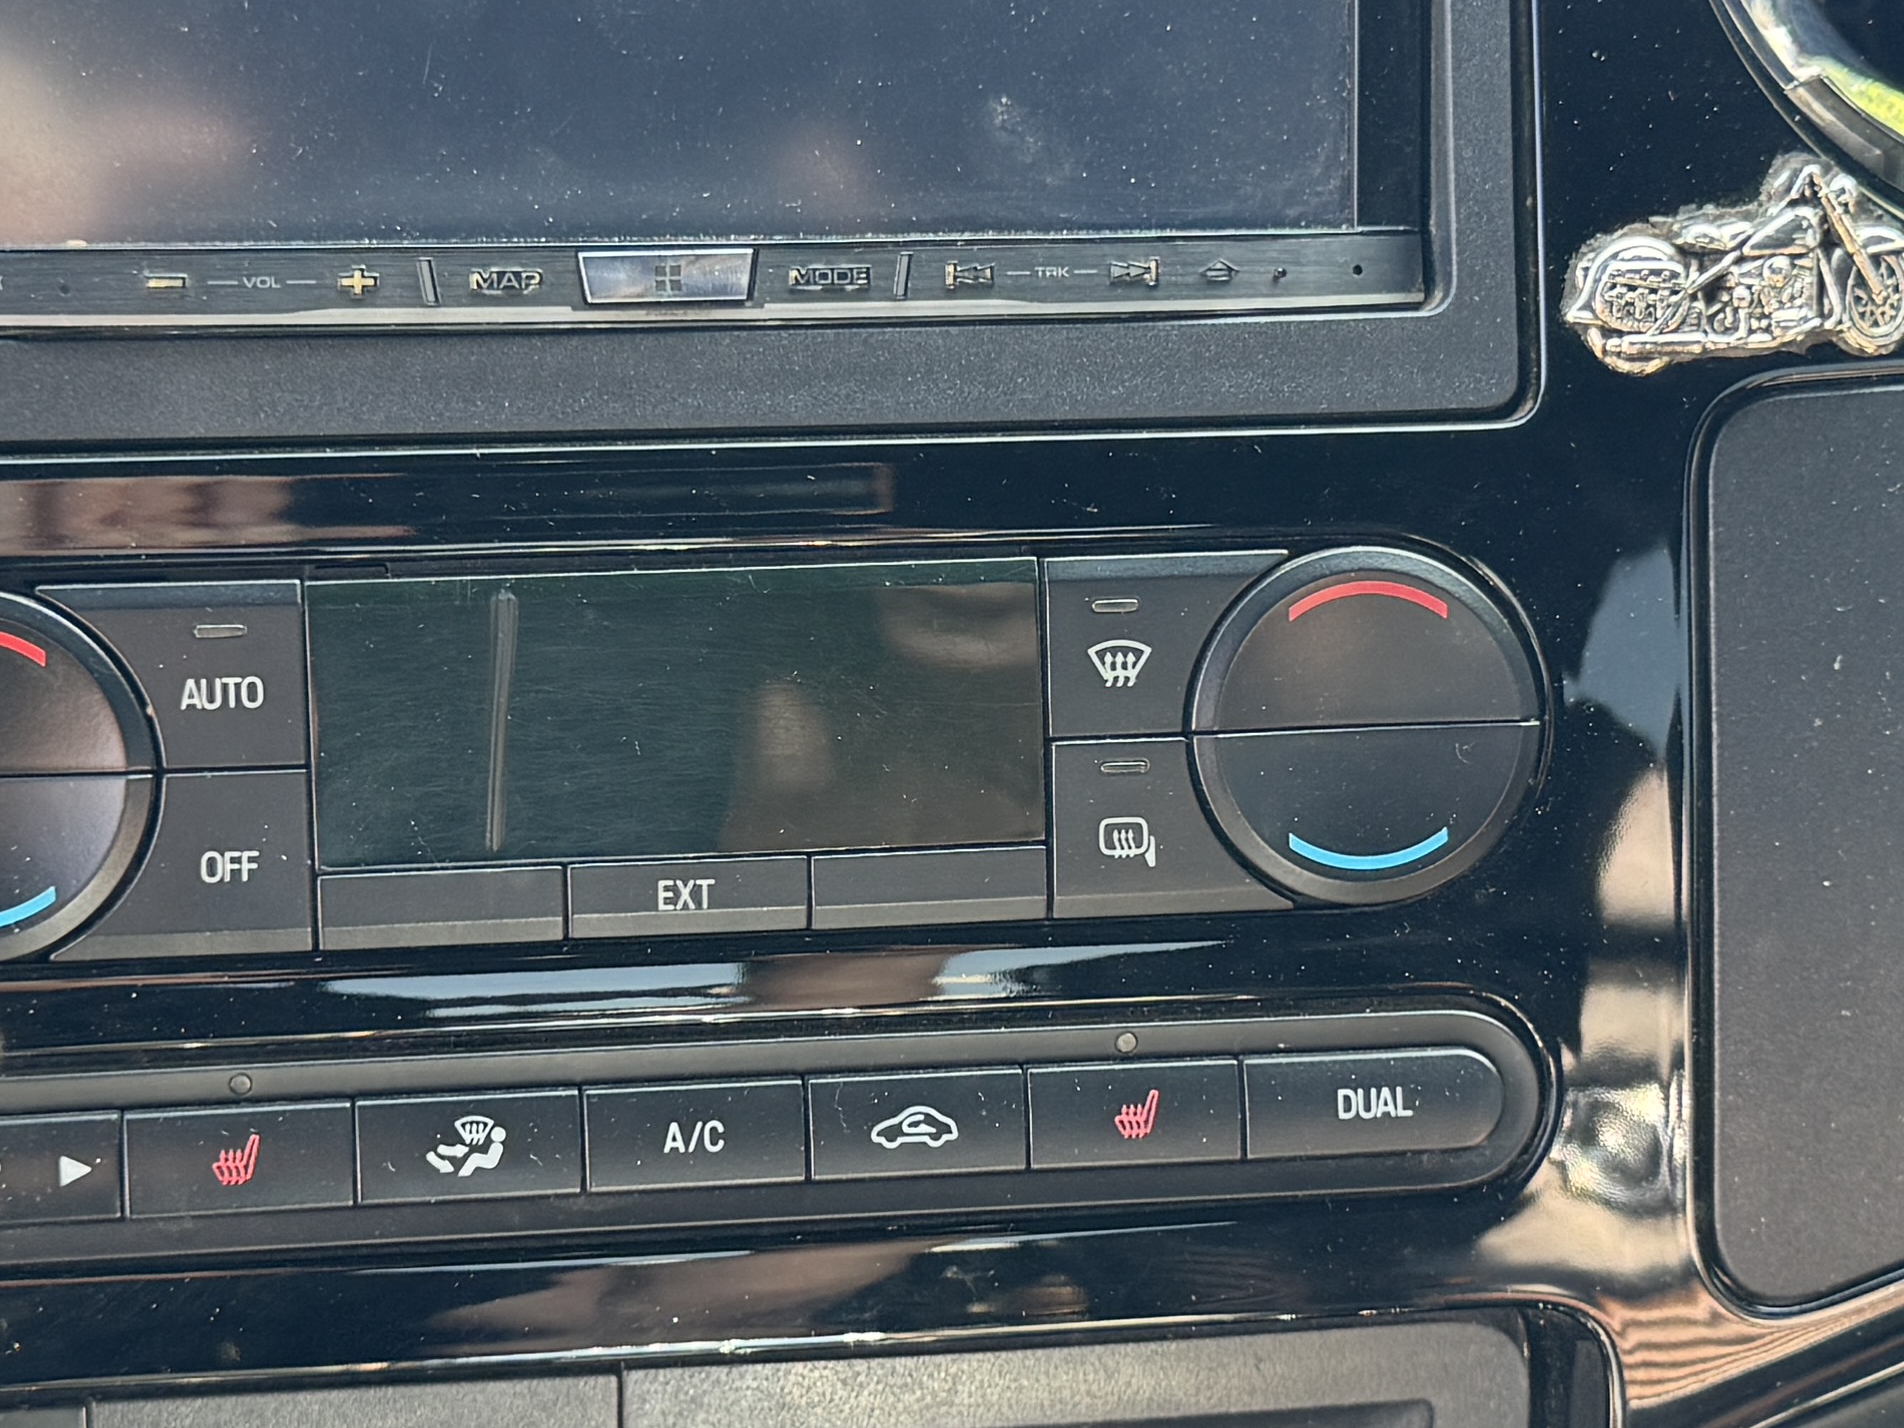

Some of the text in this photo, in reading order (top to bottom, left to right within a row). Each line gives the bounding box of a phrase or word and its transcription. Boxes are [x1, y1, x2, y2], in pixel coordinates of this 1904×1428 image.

[242, 276, 282, 289] VOL
[470, 269, 543, 293] MAP
[789, 265, 872, 290] MODE
[1034, 266, 1070, 278] TRK
[180, 676, 264, 710] AUTO
[200, 850, 260, 884] OFF
[657, 878, 716, 911] EXT
[1337, 1085, 1414, 1120] DUAL
[663, 1119, 725, 1154] A/C
